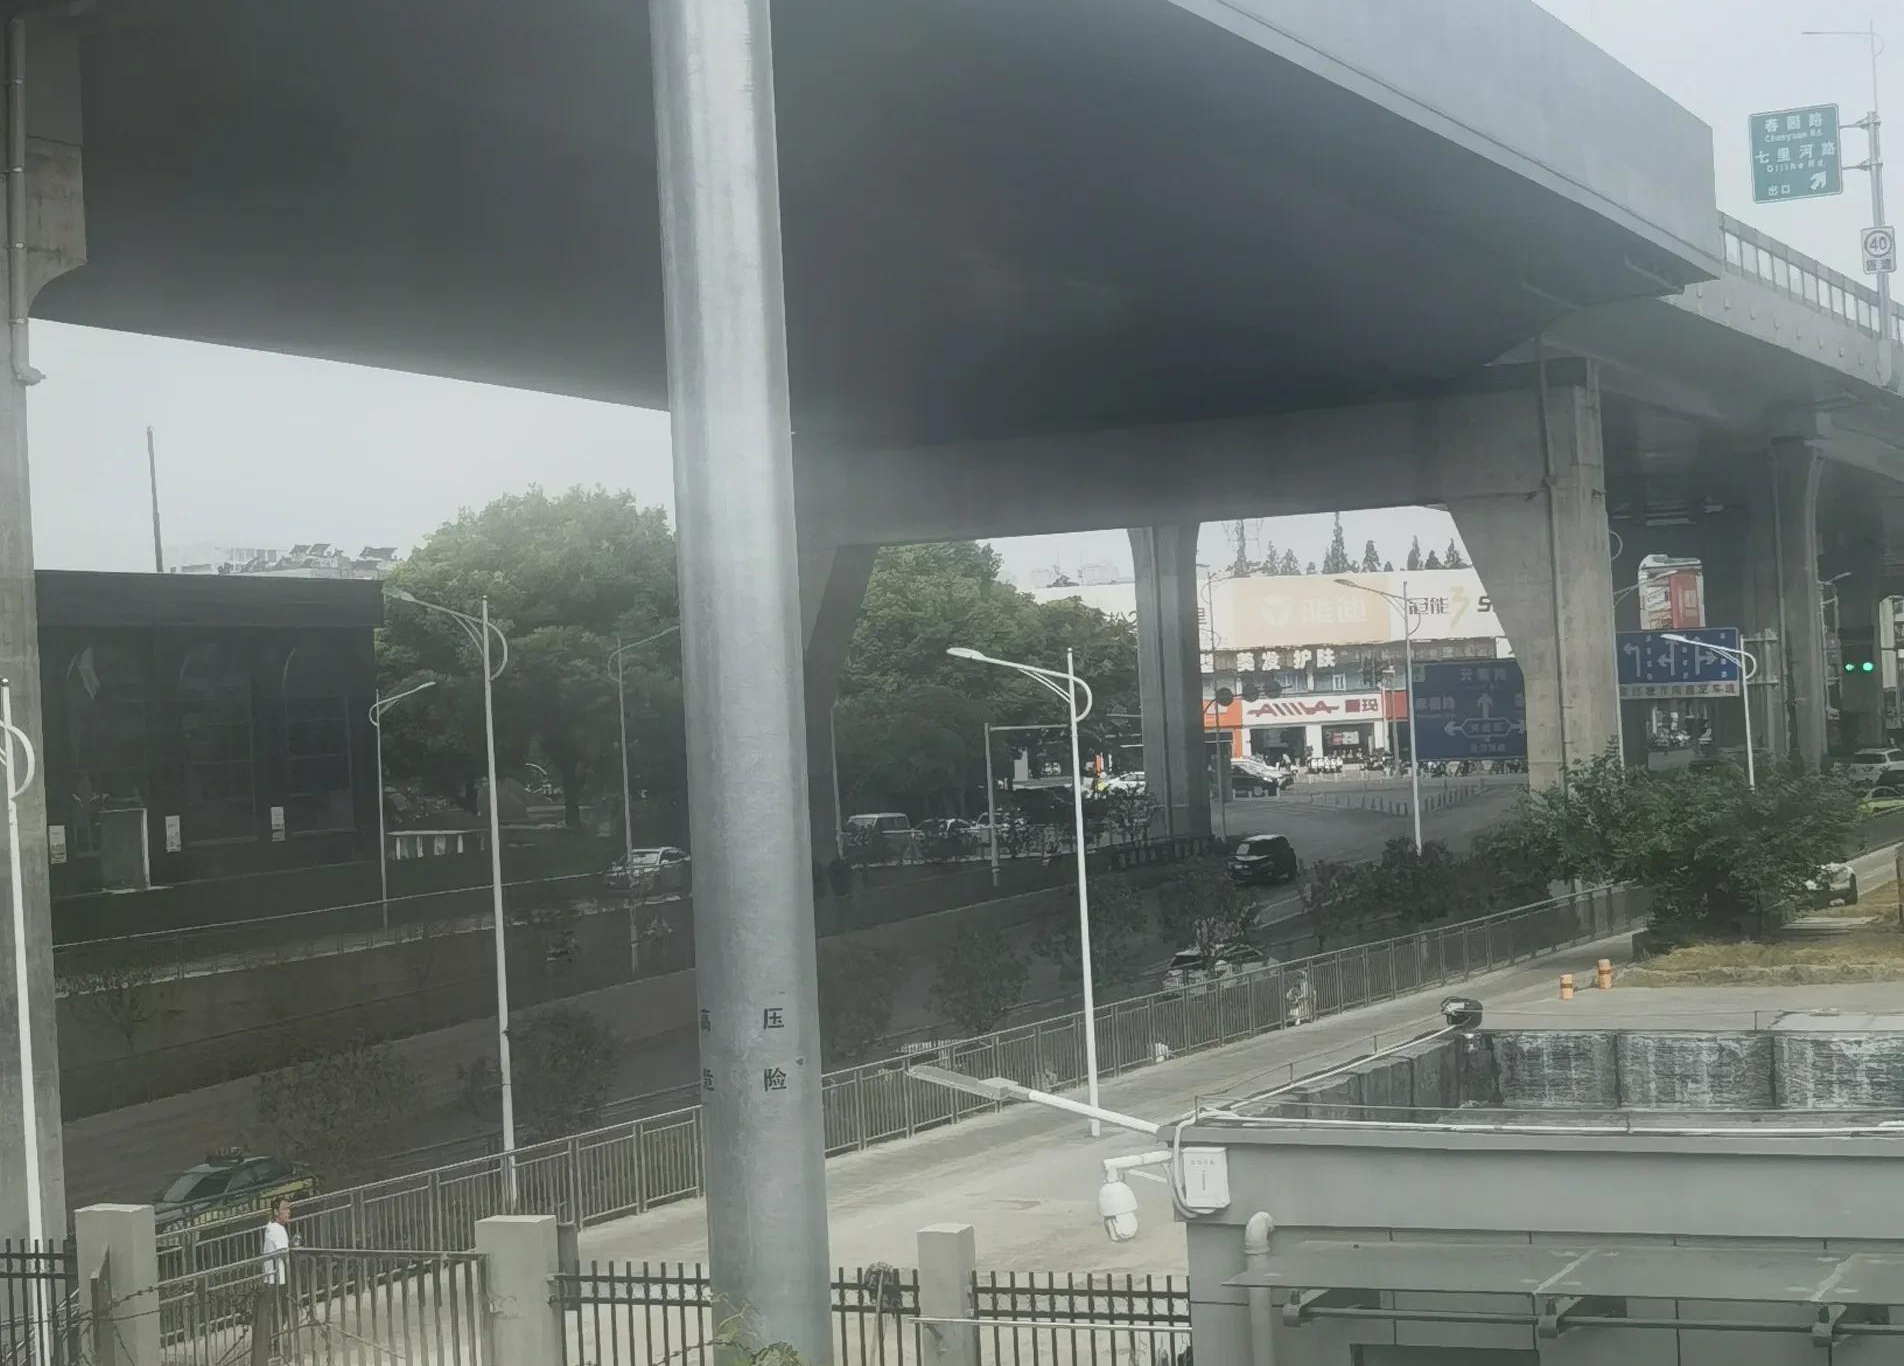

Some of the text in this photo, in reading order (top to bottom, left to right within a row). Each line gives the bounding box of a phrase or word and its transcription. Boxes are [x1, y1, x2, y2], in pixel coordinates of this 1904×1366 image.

[1755, 141, 1835, 164] 七里河路
[1768, 184, 1790, 196] 出口
[1869, 236, 1887, 252] 40
[1301, 599, 1369, 623] 雅迪
